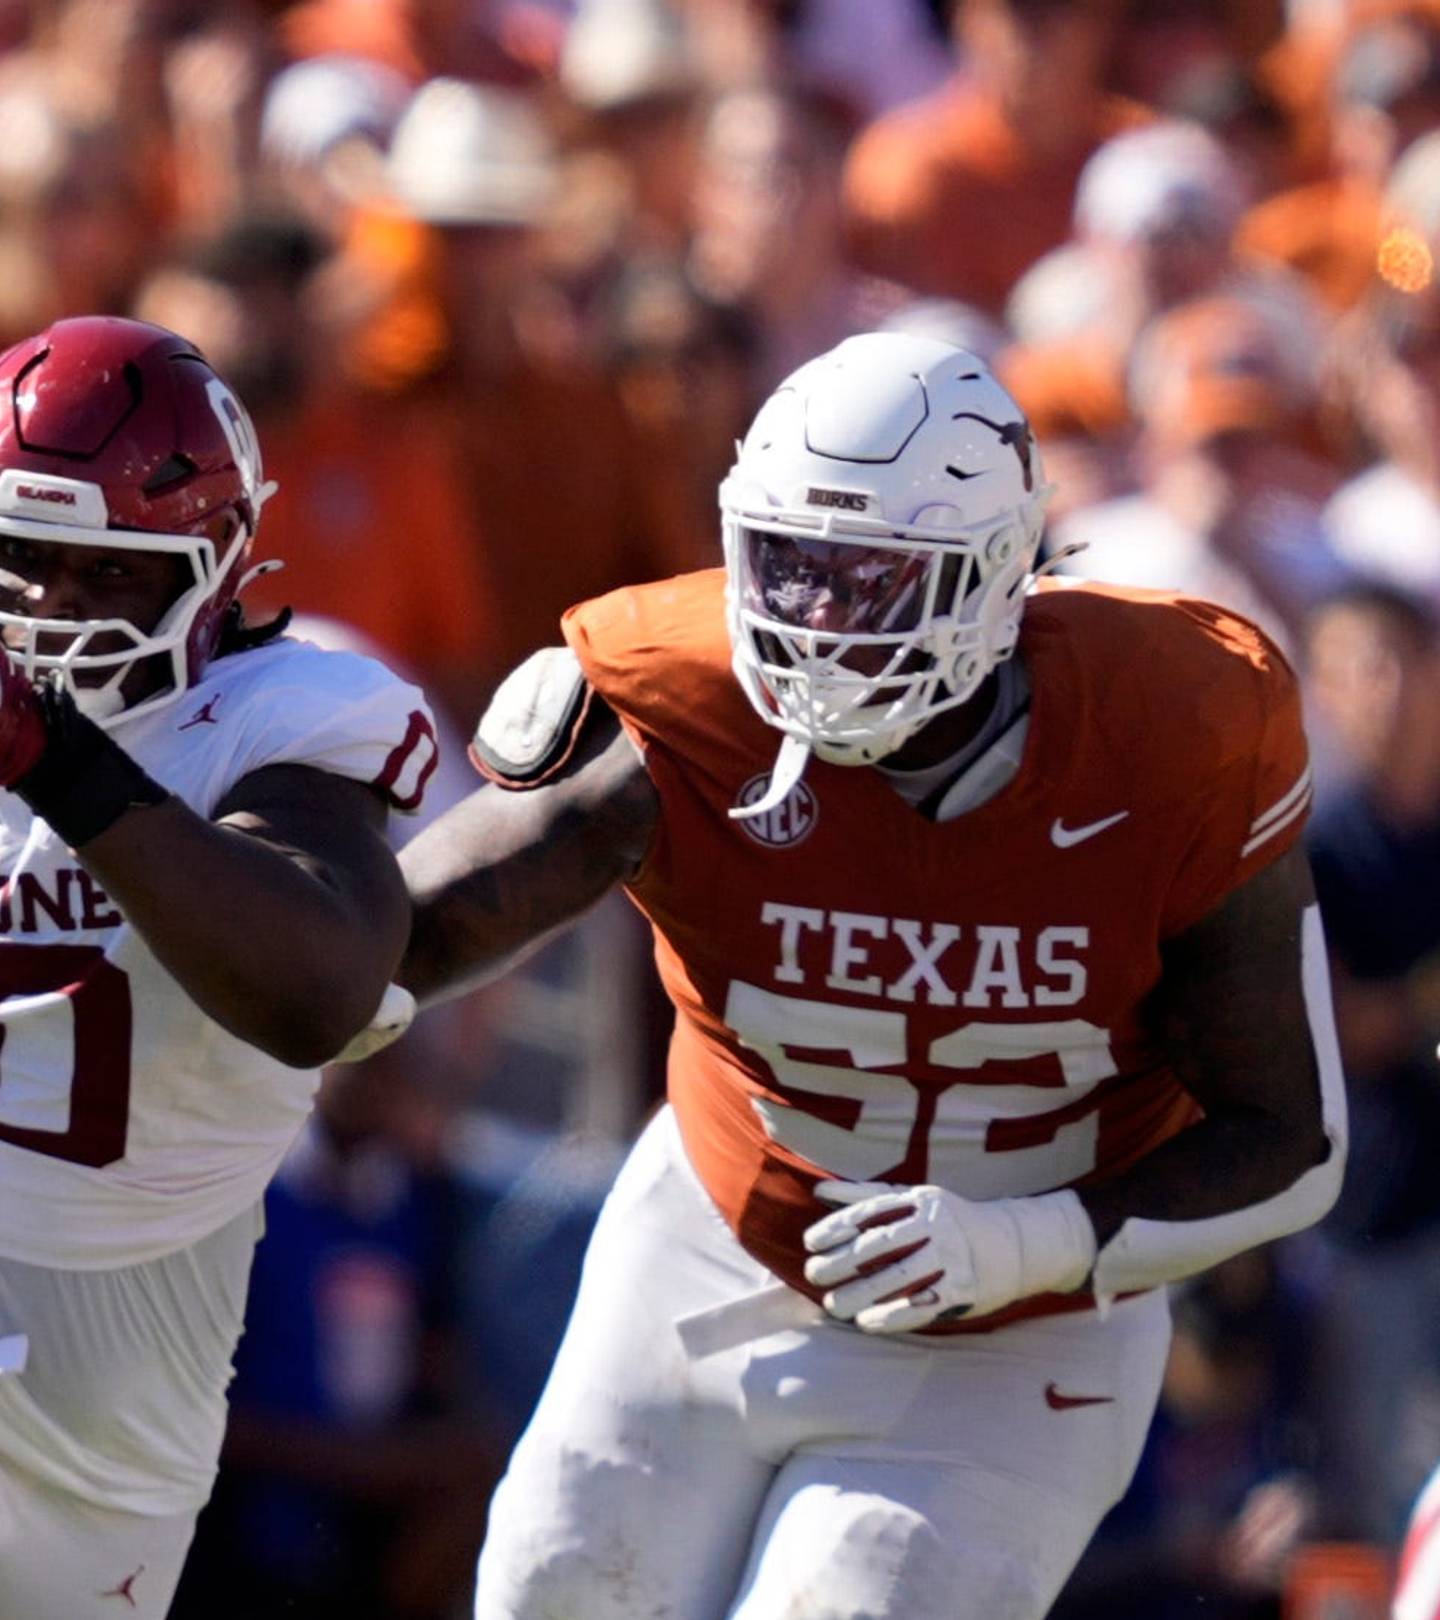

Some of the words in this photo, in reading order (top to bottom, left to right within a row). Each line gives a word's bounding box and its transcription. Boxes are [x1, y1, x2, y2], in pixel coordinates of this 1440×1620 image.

[375, 710, 439, 811] 0
[761, 902, 1090, 1009] TEXAS
[724, 978, 1118, 1198] 52
